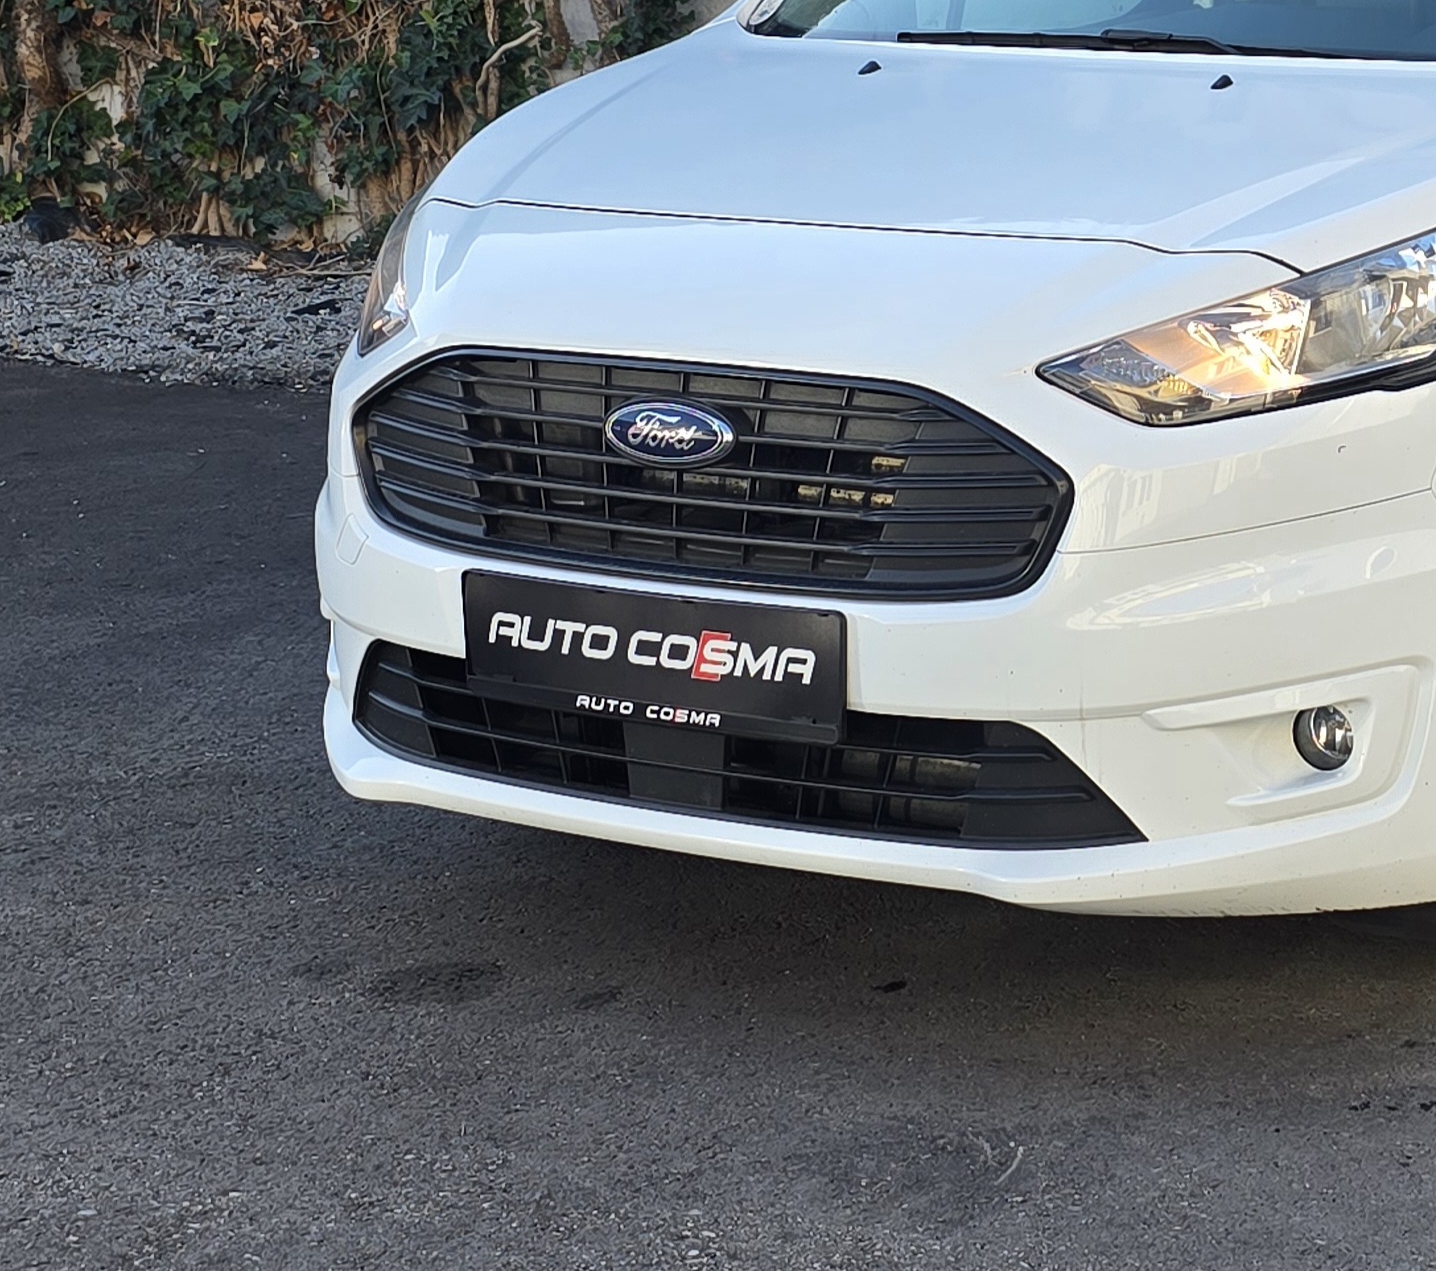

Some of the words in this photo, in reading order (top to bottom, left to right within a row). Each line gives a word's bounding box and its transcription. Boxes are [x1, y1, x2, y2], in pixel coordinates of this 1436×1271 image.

[627, 411, 697, 450] Ford
[488, 611, 617, 661] AUTO
[627, 631, 816, 685] COSMA
[575, 694, 634, 716] AUTO
[646, 704, 721, 728] COSMA
